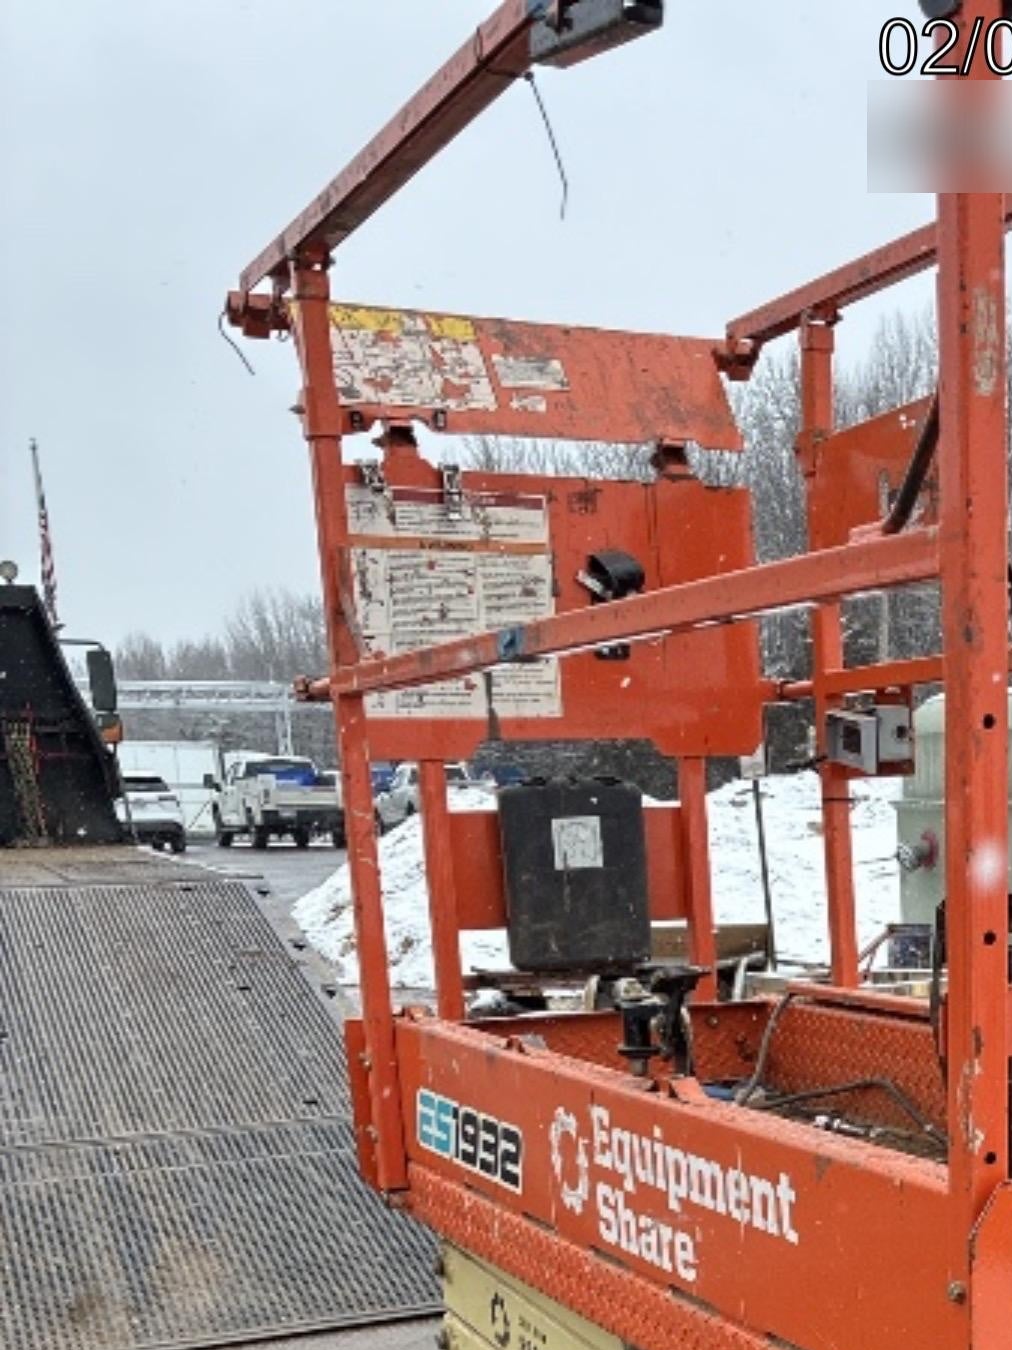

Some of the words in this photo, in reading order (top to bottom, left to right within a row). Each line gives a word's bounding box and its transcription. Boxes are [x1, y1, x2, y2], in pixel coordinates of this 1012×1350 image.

[417, 1087, 522, 1195] ES1932
[590, 1104, 800, 1246] Equipment
[596, 1180, 697, 1282] Share
